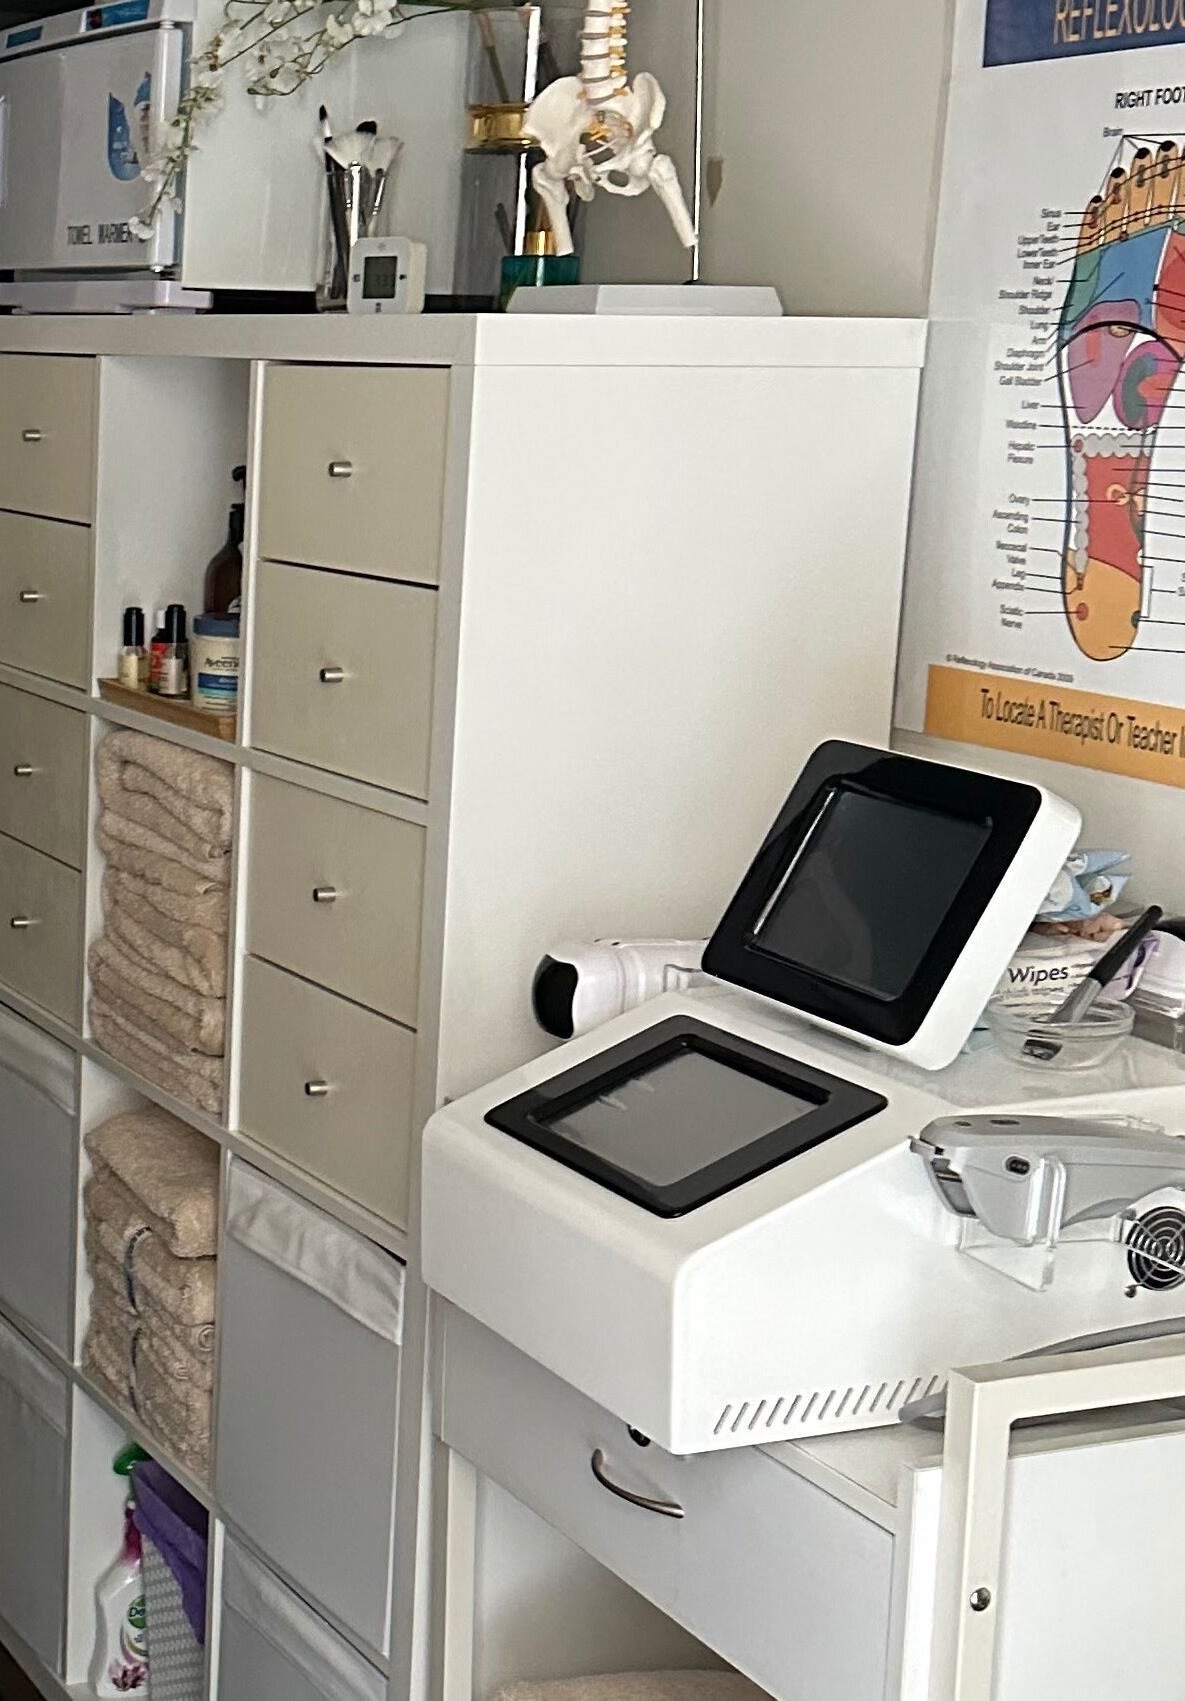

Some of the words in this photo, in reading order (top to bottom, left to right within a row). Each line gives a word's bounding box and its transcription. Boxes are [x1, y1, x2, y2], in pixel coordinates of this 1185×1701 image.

[1053, 0, 1185, 44] REFLEXOLO
[1115, 89, 1153, 109] RIGHT
[67, 224, 93, 245] TOWEL
[1047, 222, 1061, 231] Ear
[981, 688, 994, 719] To
[995, 691, 1035, 727] Locate
[1036, 700, 1046, 729] A
[1049, 701, 1105, 746] Therapist
[1107, 712, 1124, 744] Or
[1126, 715, 1177, 755] Teacher
[1007, 965, 1069, 987] Wipes
